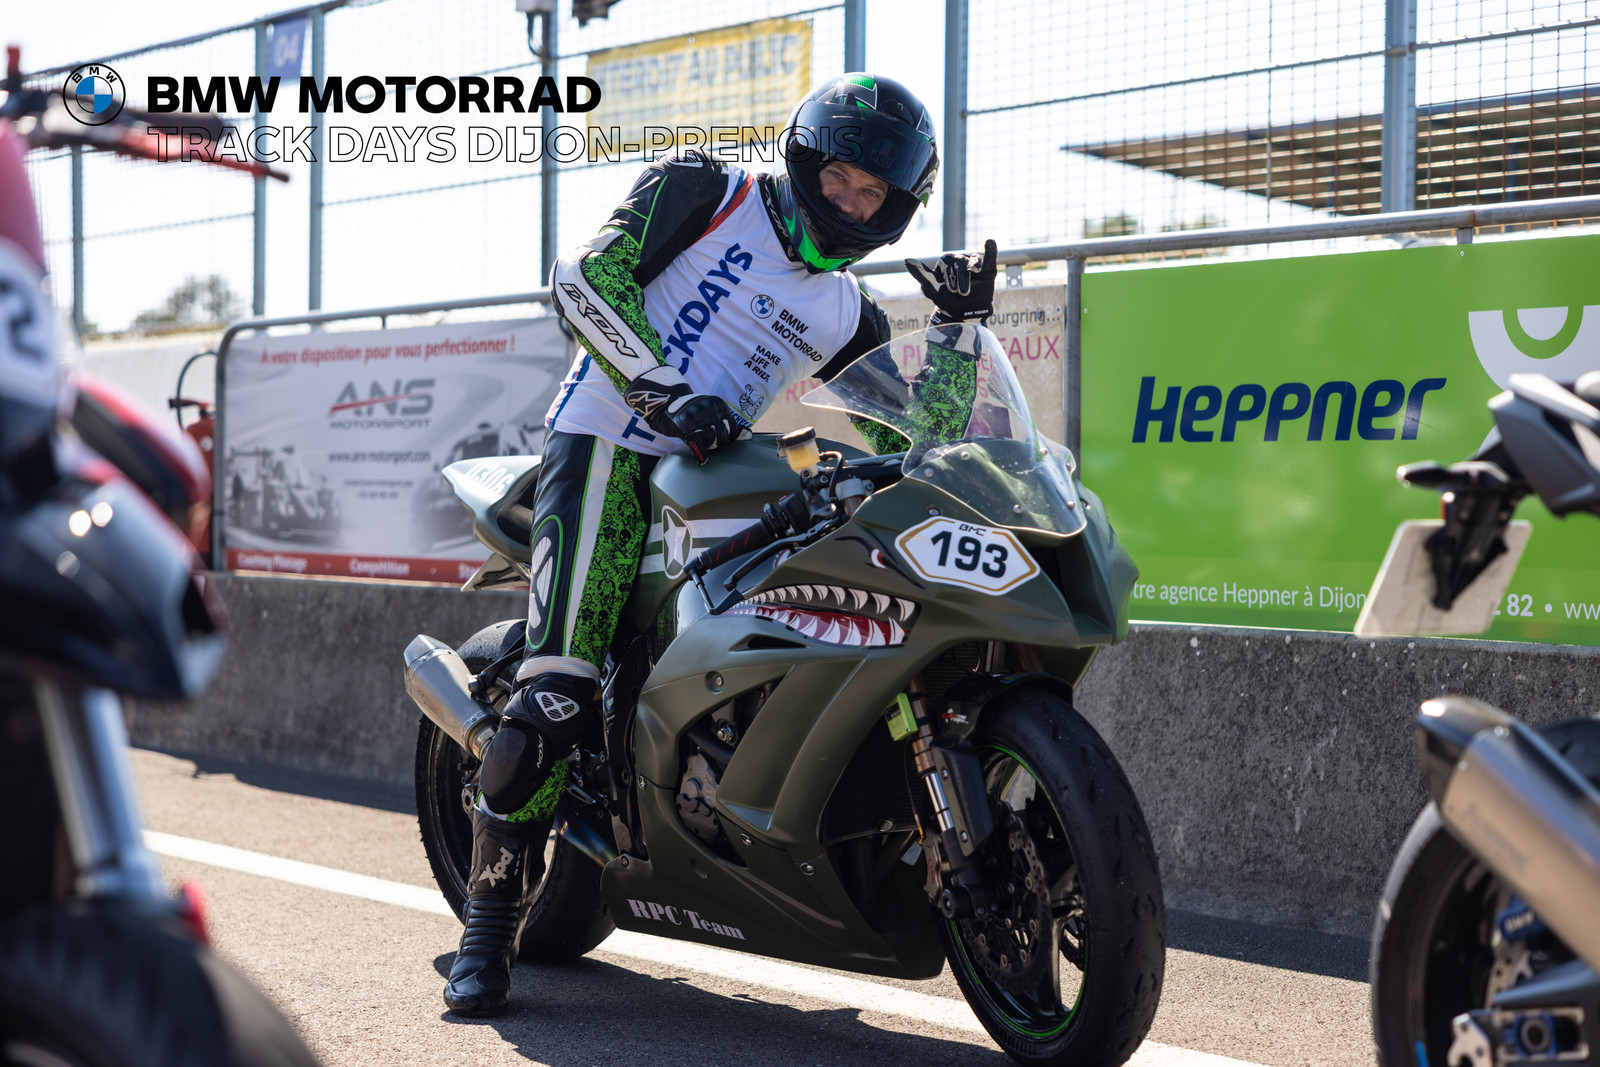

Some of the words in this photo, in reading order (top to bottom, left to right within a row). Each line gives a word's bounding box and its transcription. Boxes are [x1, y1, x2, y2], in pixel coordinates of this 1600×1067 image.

[779, 309, 809, 335] BMW
[271, 350, 298, 364] votre
[302, 346, 361, 367] disposition
[364, 346, 394, 366] pour
[396, 344, 422, 360] vous
[425, 337, 507, 362] perfectionner
[771, 320, 823, 362] MOTORRAD
[744, 360, 753, 369] A
[750, 353, 770, 370] LIFE
[755, 345, 781, 366] MAKE
[329, 379, 435, 416] ANS
[330, 418, 430, 430] MOTORSPORT
[931, 530, 1008, 578] 193
[1160, 585, 1217, 605] agence
[1223, 582, 1298, 609] Heppner
[1304, 585, 1313, 607] à
[1319, 586, 1367, 613] Dijon
[1507, 593, 1533, 617] 82
[626, 899, 682, 926] RPC
[682, 909, 746, 940] Team
